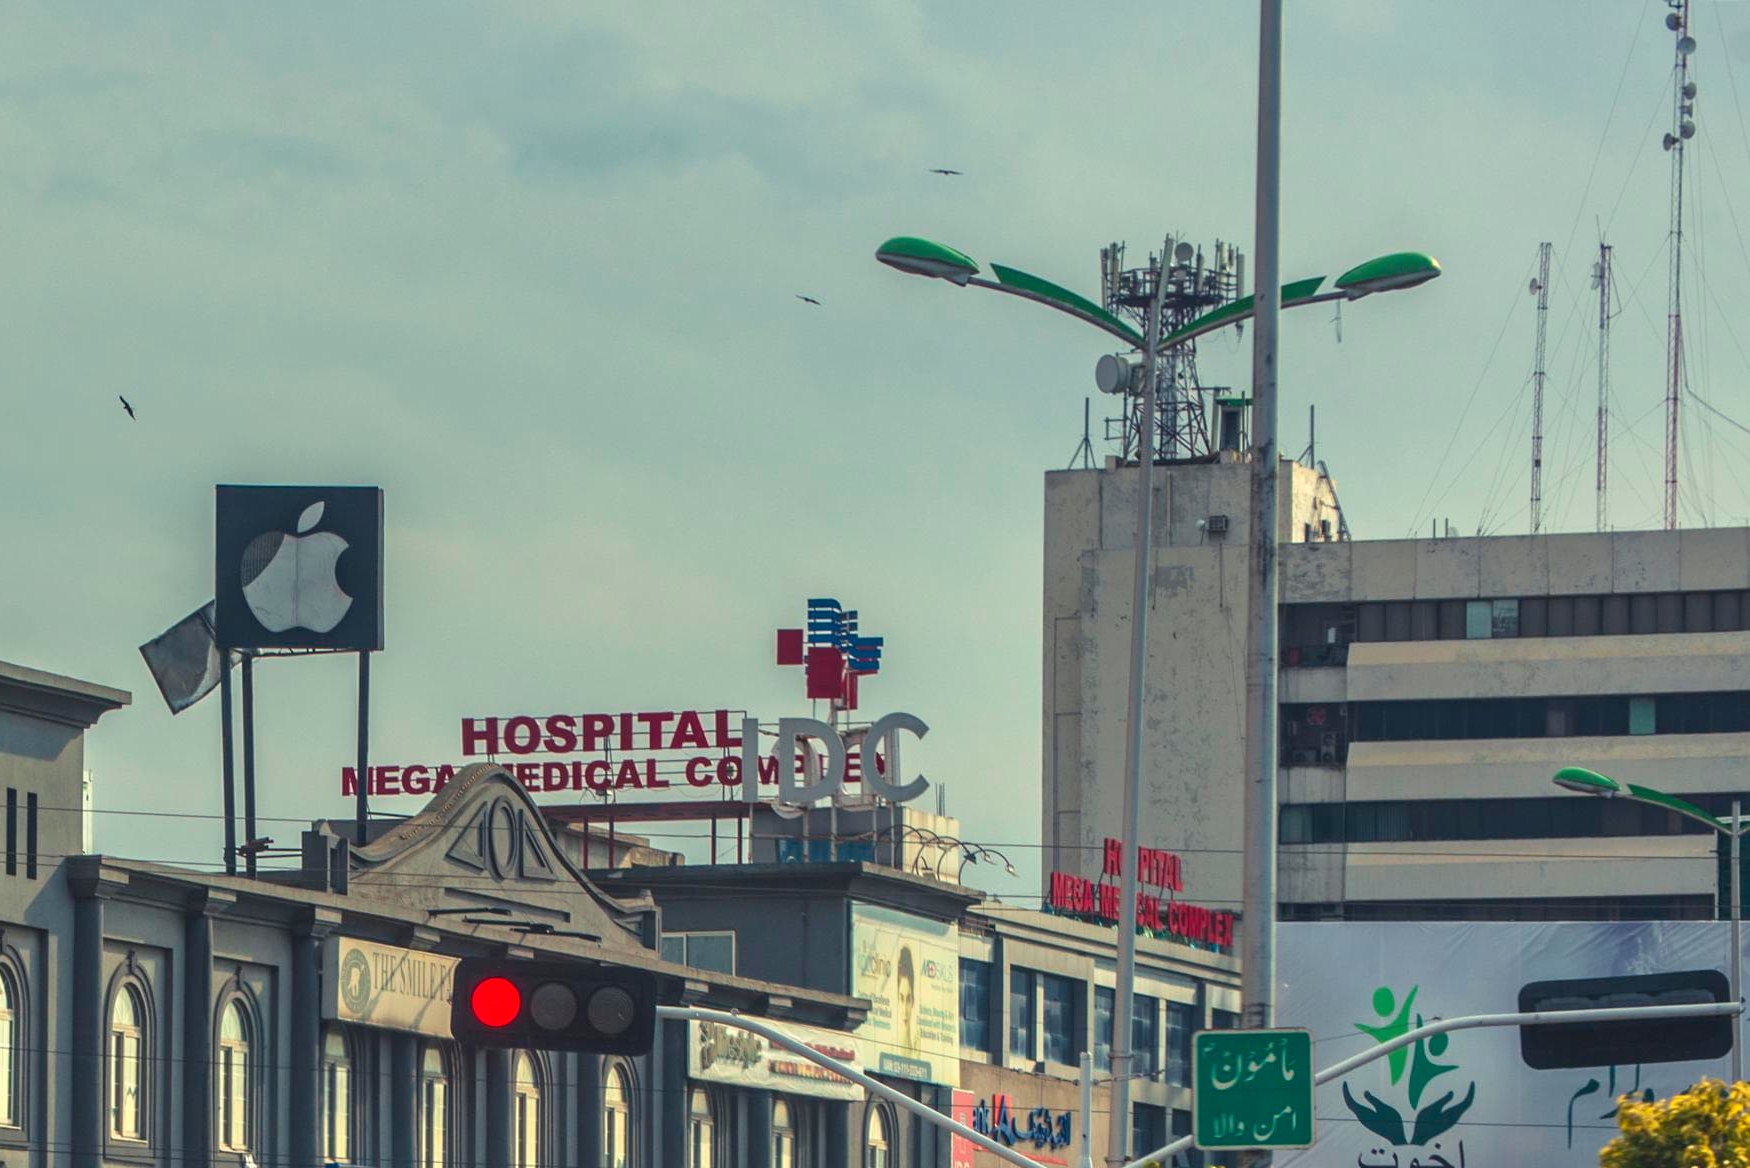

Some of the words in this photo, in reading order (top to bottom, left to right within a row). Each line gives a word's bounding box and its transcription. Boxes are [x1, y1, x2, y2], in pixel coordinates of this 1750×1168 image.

[461, 709, 743, 755] HOSPITAL
[342, 764, 456, 797] MEGA
[742, 711, 930, 803] IDC
[1104, 838, 1183, 892] HOPITAL
[1051, 871, 1094, 914] MEGA
[1099, 883, 1164, 930] MECAL
[1168, 900, 1234, 948] COMPLEX
[372, 951, 397, 993] THE
[400, 956, 436, 1001] SMILE
[1213, 1112, 1245, 1138] والا
[1253, 1105, 1297, 1141] امن
